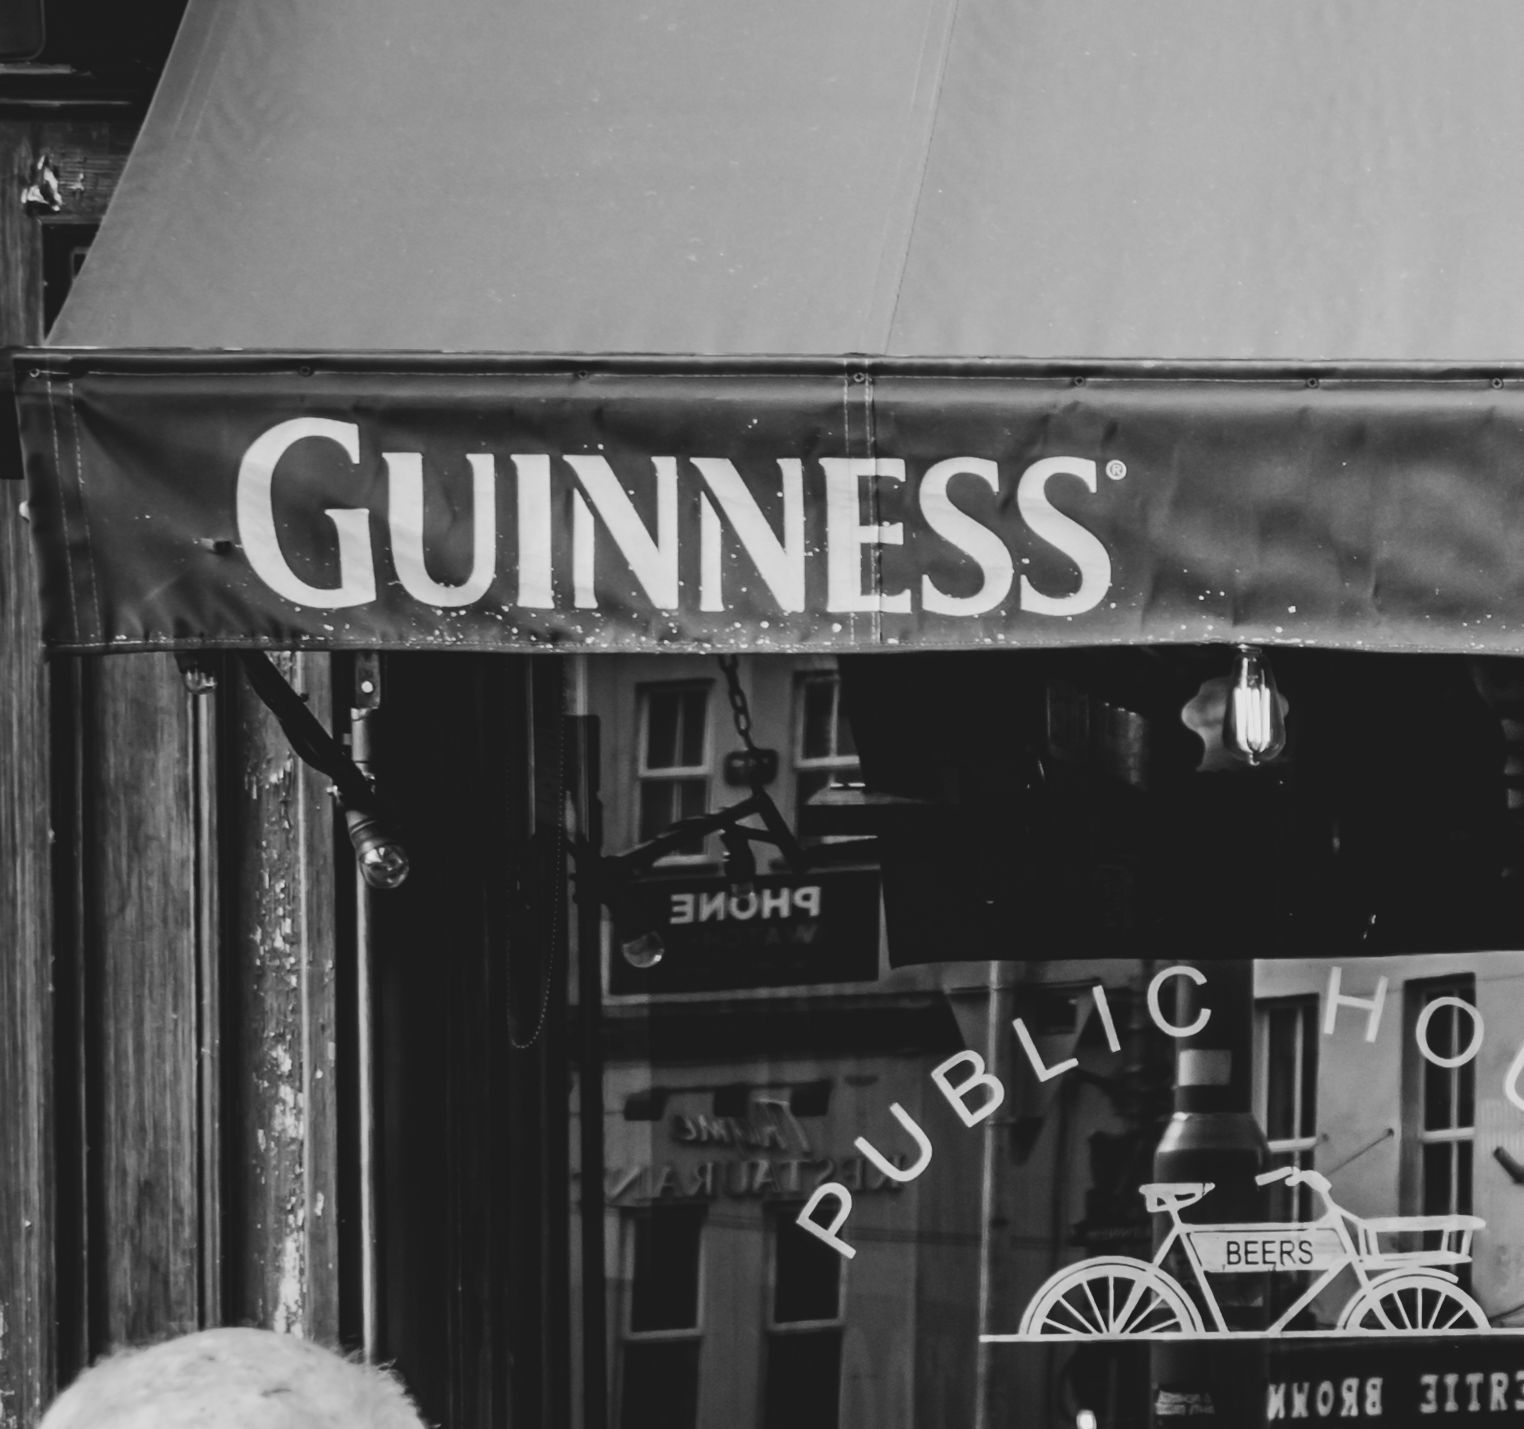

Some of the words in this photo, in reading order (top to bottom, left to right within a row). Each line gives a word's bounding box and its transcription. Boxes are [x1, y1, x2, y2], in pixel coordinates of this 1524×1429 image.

[237, 416, 1114, 618] GUINNESS
[795, 964, 1213, 1260] PUBLIC
[1225, 1237, 1315, 1267] BEERS
